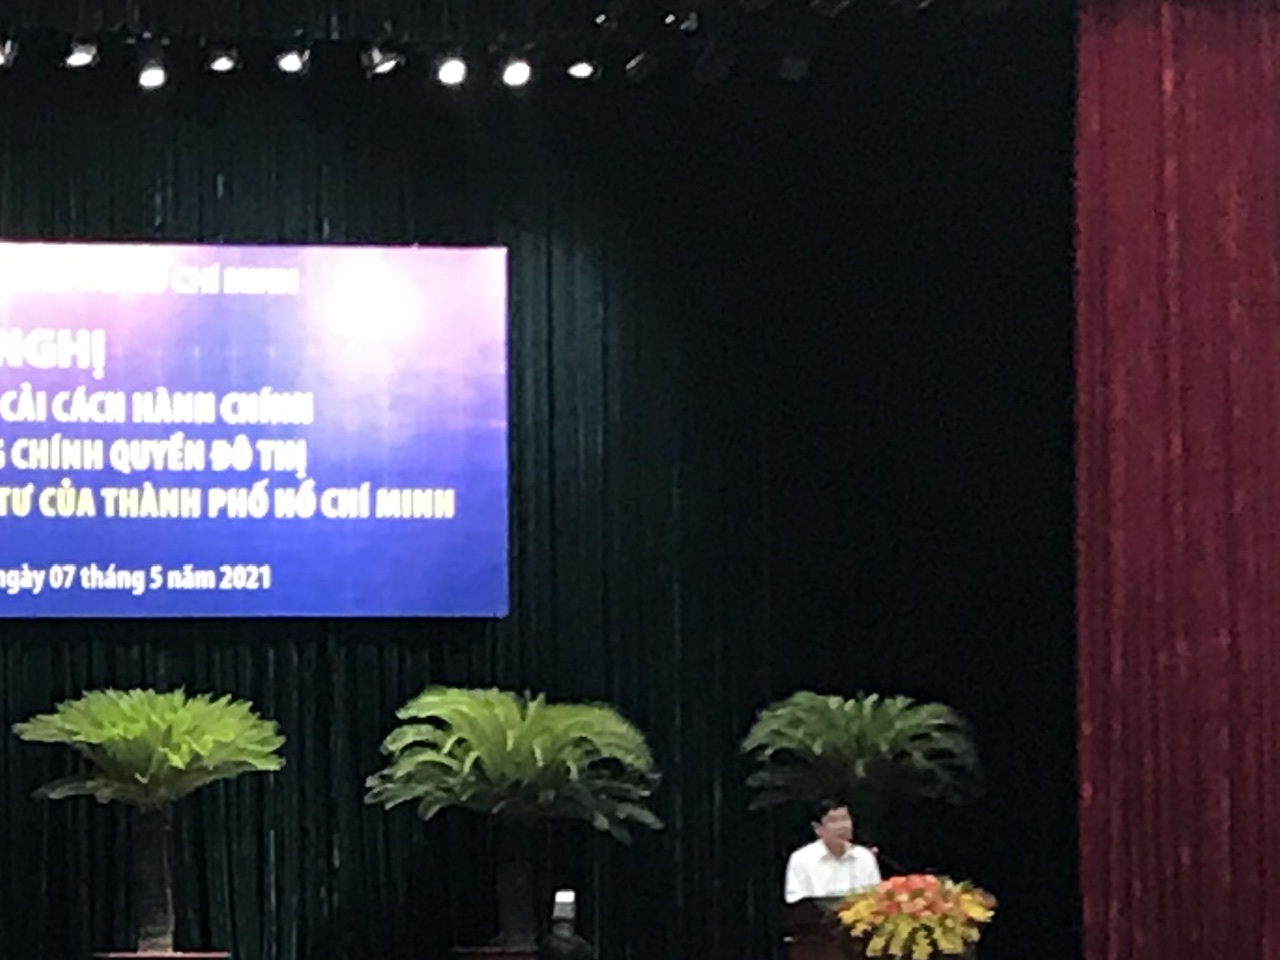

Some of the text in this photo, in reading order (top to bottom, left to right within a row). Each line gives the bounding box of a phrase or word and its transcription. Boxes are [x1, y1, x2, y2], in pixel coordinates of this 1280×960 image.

[0, 382, 47, 422] CẢI
[51, 385, 126, 423] CÁCH
[10, 433, 104, 471] CHÍNH
[209, 433, 254, 472] ĐÔ
[255, 439, 308, 479] THỊ
[38, 477, 96, 518] CỦA
[100, 480, 202, 519] THÀNH
[207, 477, 270, 519] PHỐ
[320, 481, 371, 519] CHÍ
[375, 488, 455, 519] MINH
[48, 563, 77, 589] 07
[79, 563, 146, 596] tháng
[149, 564, 164, 590] 5
[167, 564, 216, 590] năm
[219, 564, 271, 590] 2021
